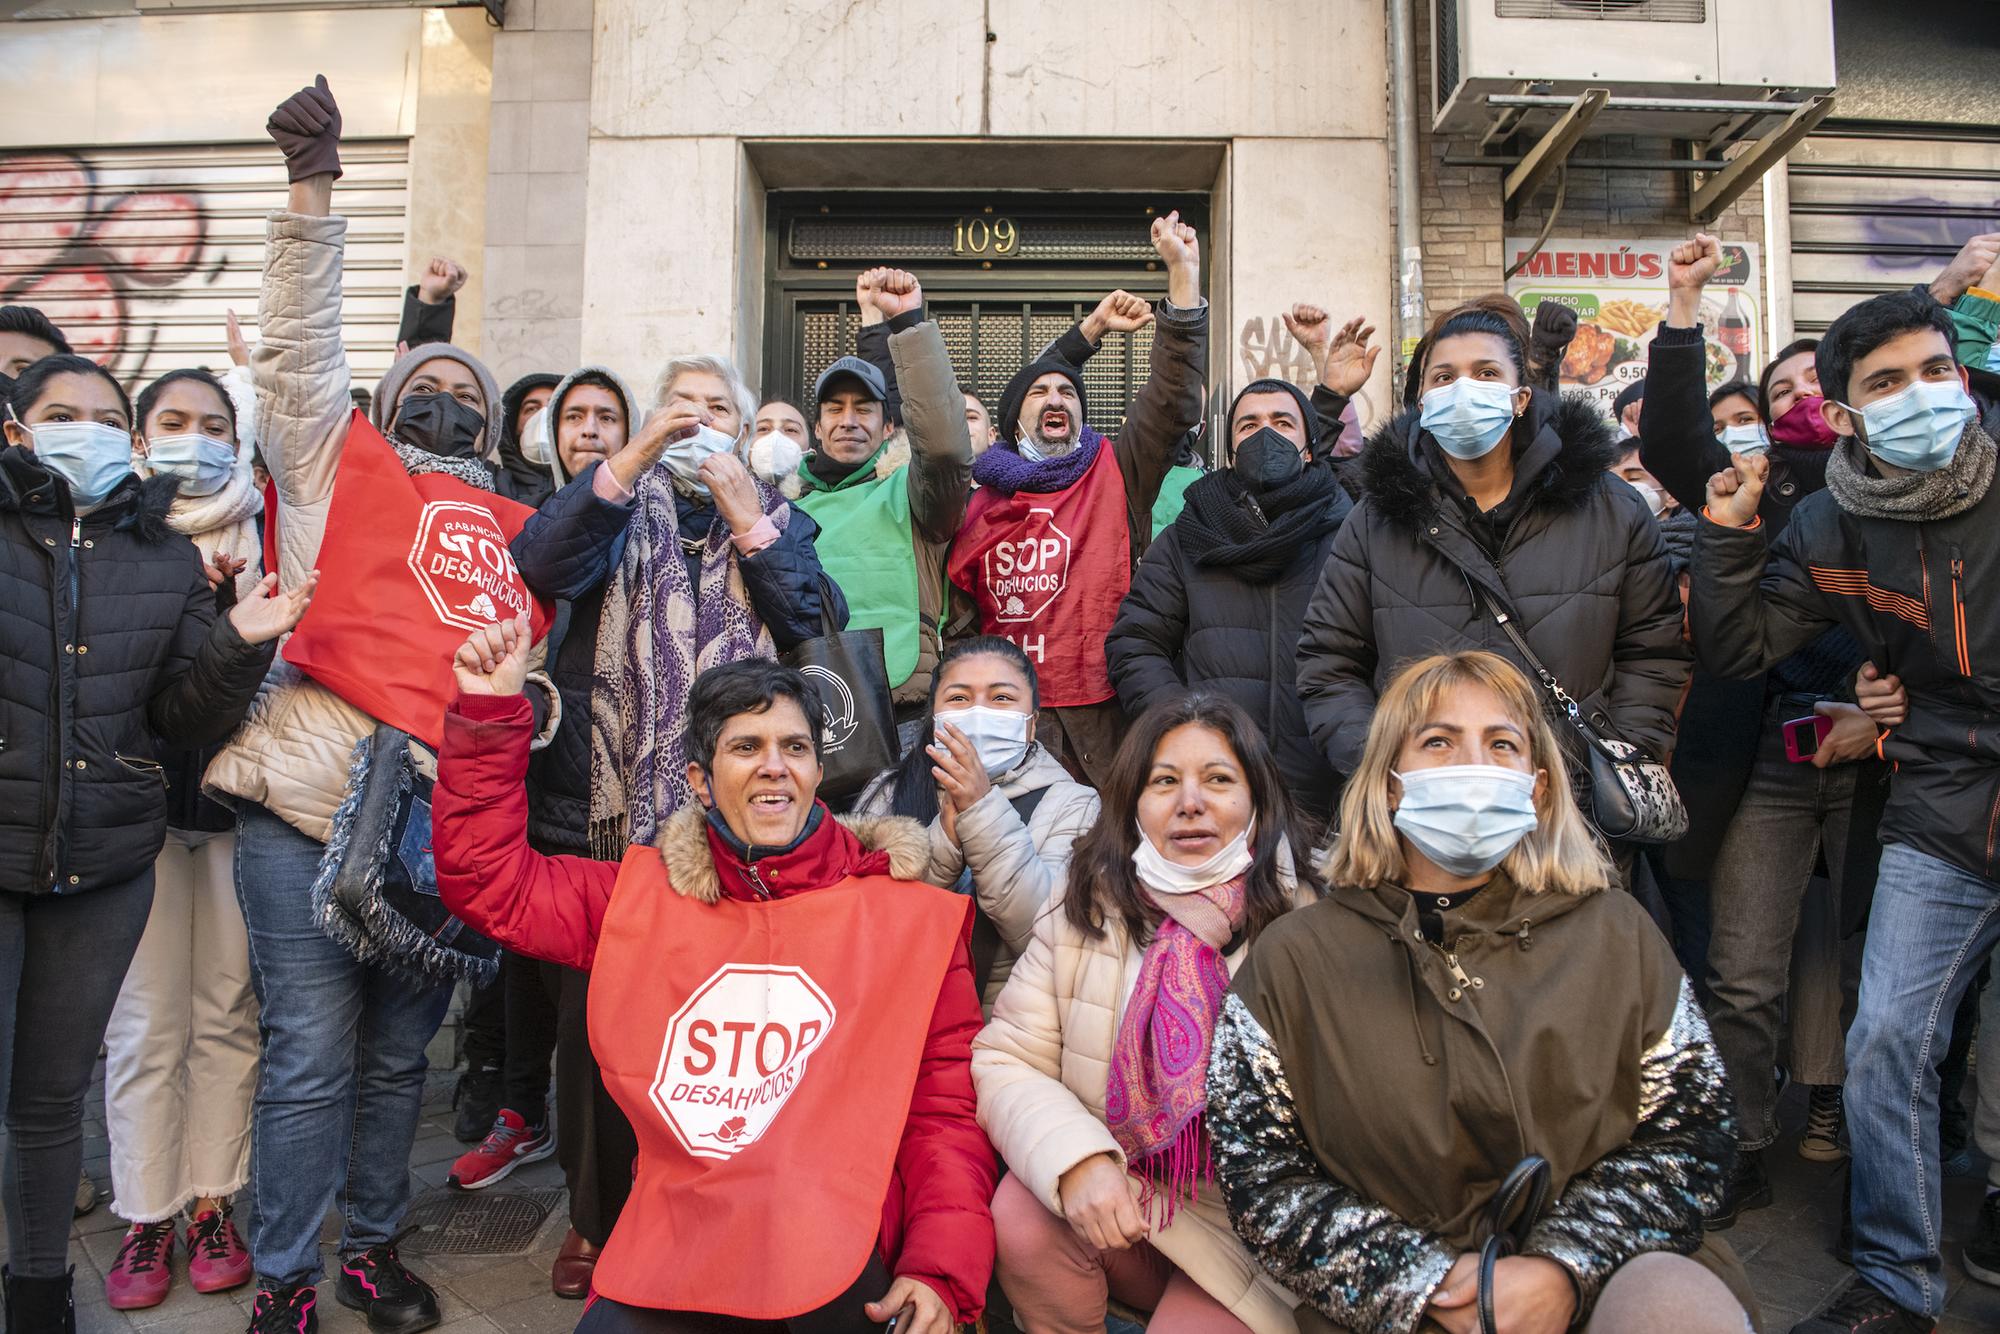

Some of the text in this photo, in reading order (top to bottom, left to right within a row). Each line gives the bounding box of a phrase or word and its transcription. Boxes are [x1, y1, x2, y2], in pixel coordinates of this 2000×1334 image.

[953, 217, 1017, 253] 109
[1516, 246, 1663, 279] MENÚS
[1540, 296, 1579, 306] PRECIO
[429, 552, 524, 614] DESAHUCIOS
[683, 1019, 822, 1078] STOP
[670, 1066, 794, 1111] DESAHUCIOS
